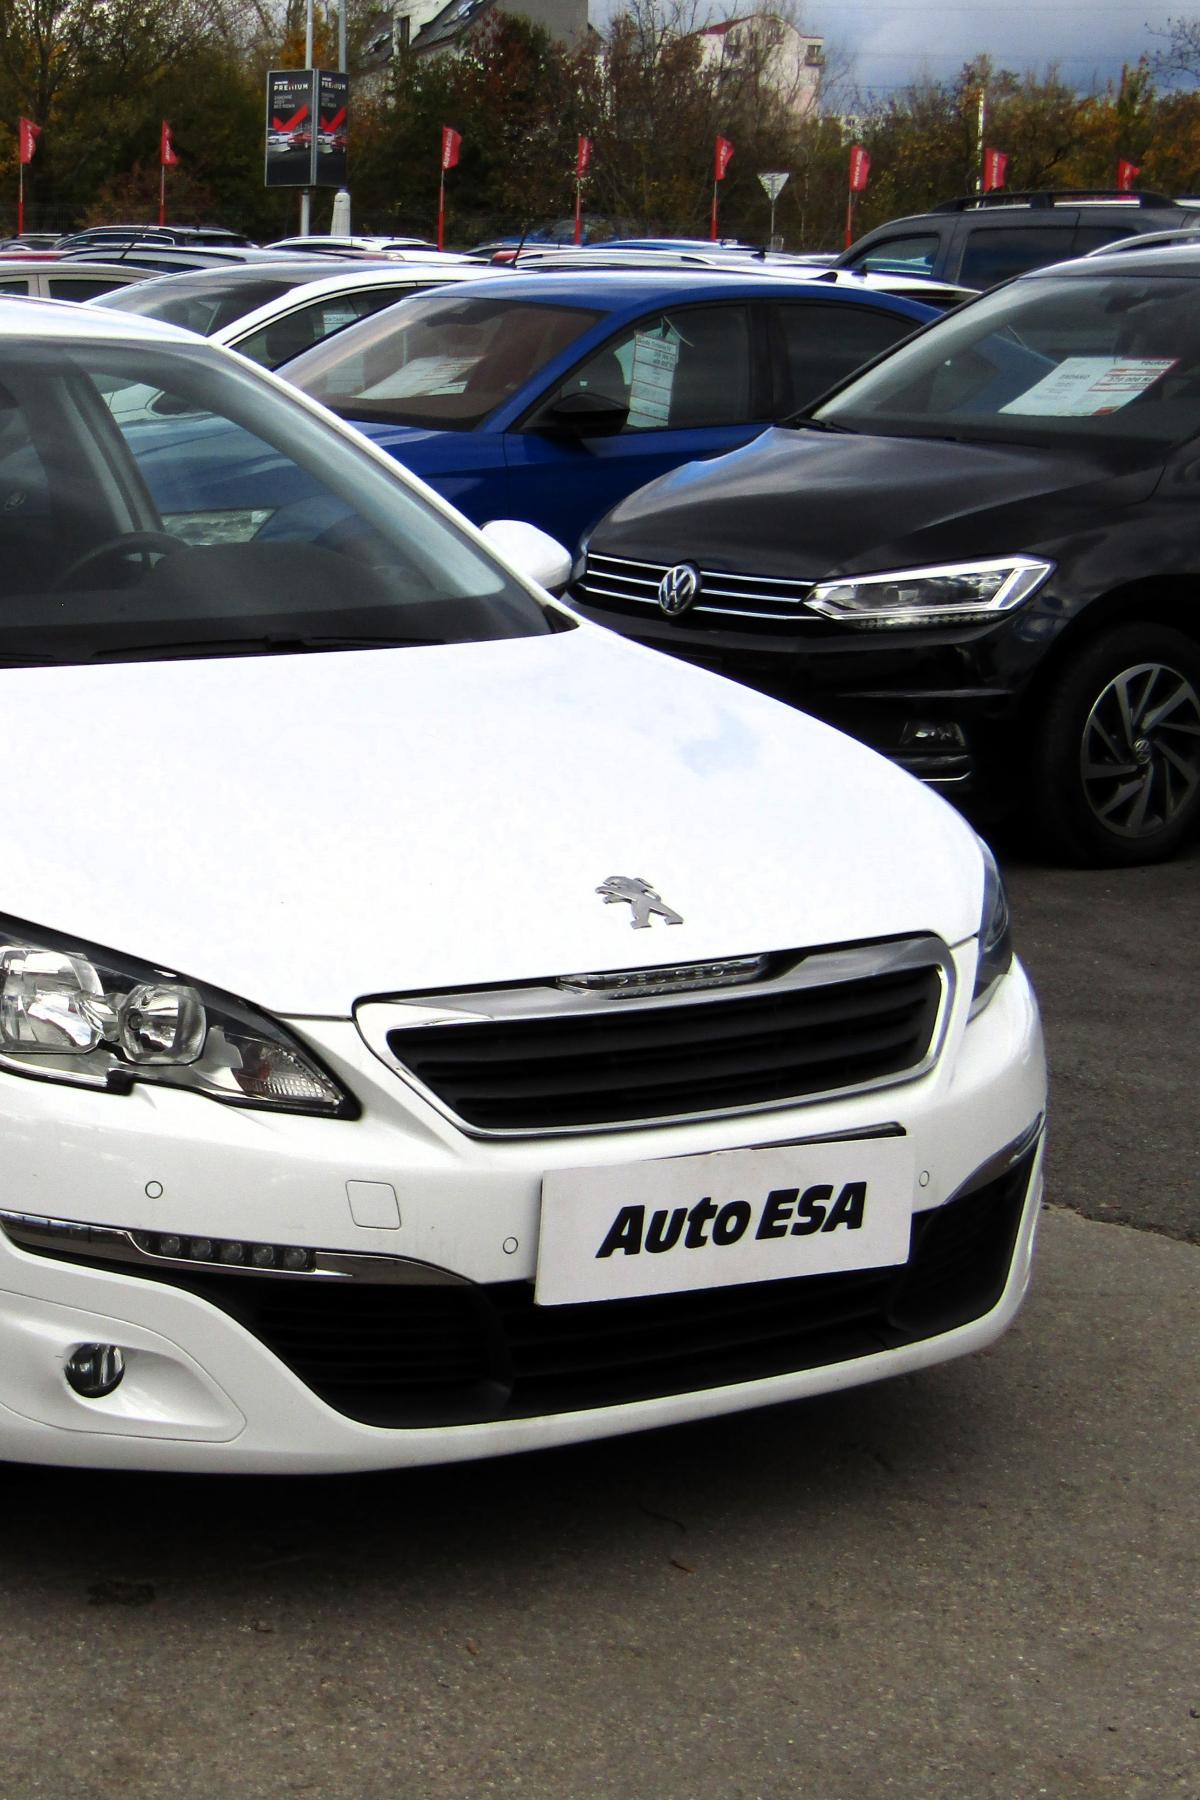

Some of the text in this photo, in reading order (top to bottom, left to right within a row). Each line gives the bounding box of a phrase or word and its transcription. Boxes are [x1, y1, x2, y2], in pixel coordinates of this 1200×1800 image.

[273, 83, 308, 91] PREMIUM
[595, 1181, 867, 1258] Auto ESA
